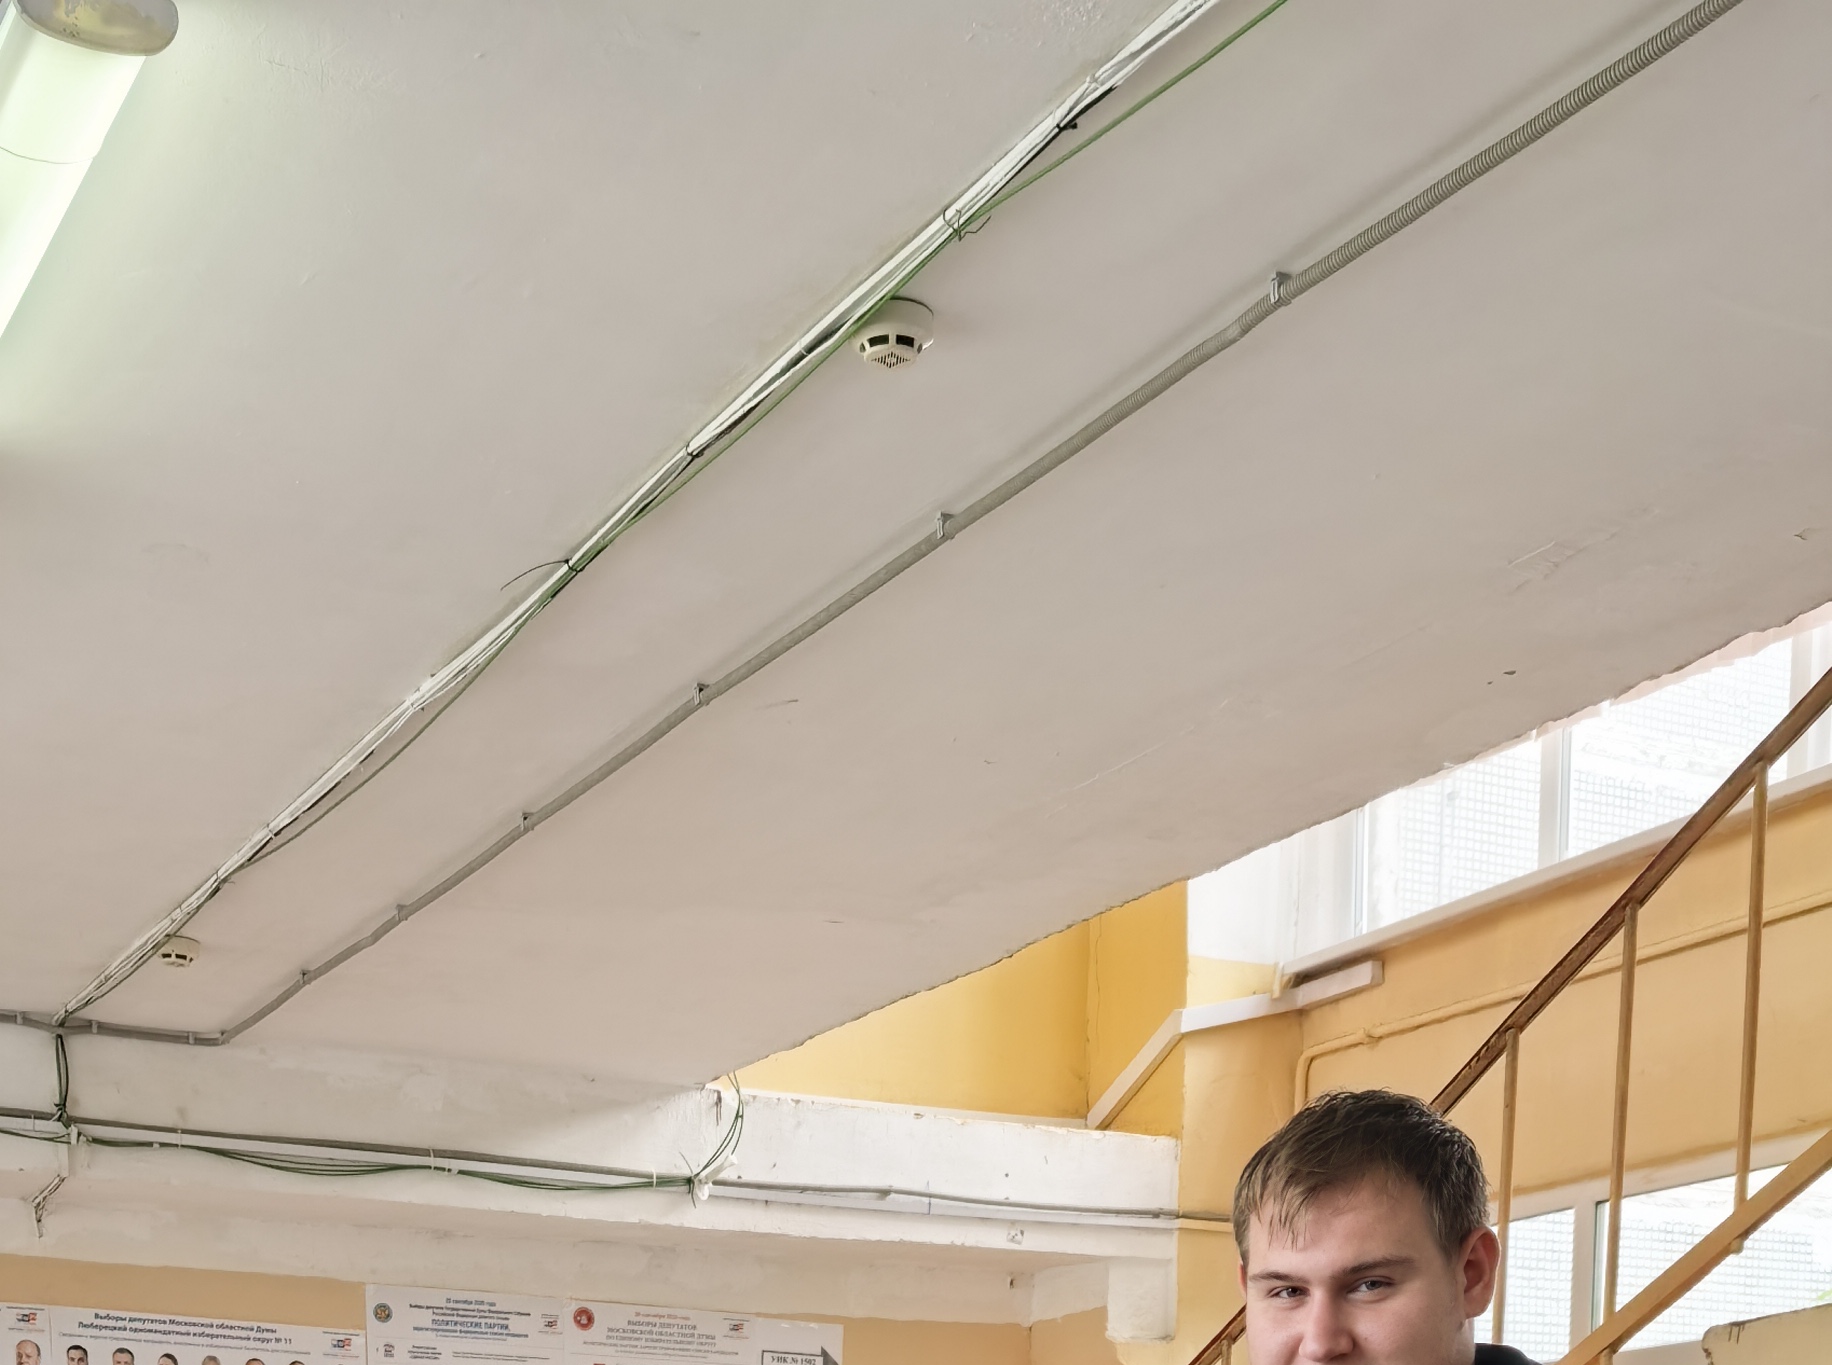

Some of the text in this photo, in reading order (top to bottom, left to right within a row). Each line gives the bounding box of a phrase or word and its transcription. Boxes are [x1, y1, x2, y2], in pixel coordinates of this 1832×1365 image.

[78, 1321, 128, 1333] Люберецкий
[128, 1326, 192, 1336] одномандатный
[94, 1312, 277, 1335] Выборы депутатов Московской областной Думы
[770, 1355, 789, 1364] УИК
[800, 1357, 817, 1365] 1502
